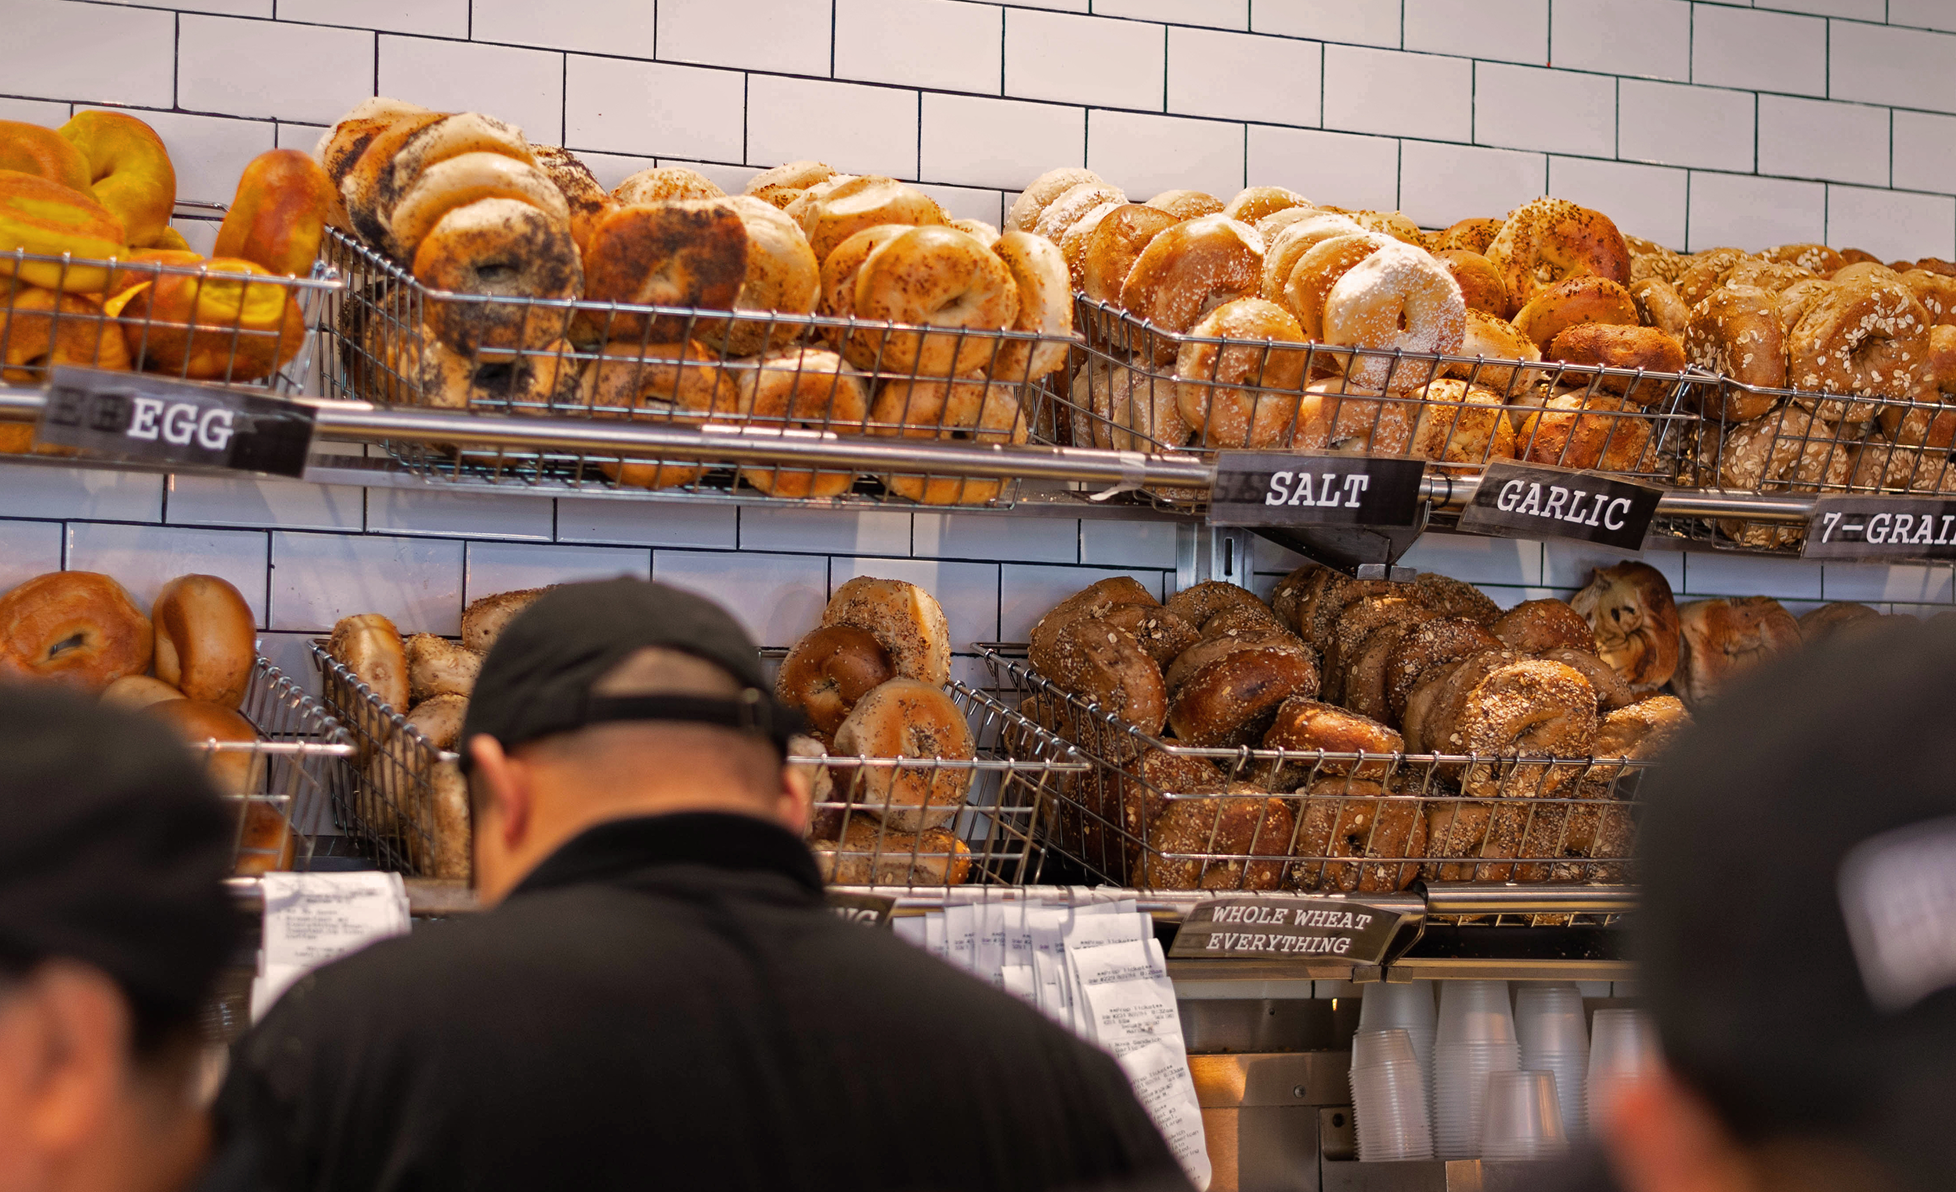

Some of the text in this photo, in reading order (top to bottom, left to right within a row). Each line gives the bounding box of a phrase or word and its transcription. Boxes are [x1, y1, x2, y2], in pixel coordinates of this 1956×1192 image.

[126, 397, 235, 451] EGG
[1265, 471, 1370, 508] SALT
[1496, 479, 1632, 531] GARLIC
[1821, 511, 1956, 546] 7-GRAI
[1211, 905, 1372, 931] WHOLE WHEAT
[1206, 932, 1351, 954] EVERYTHING
